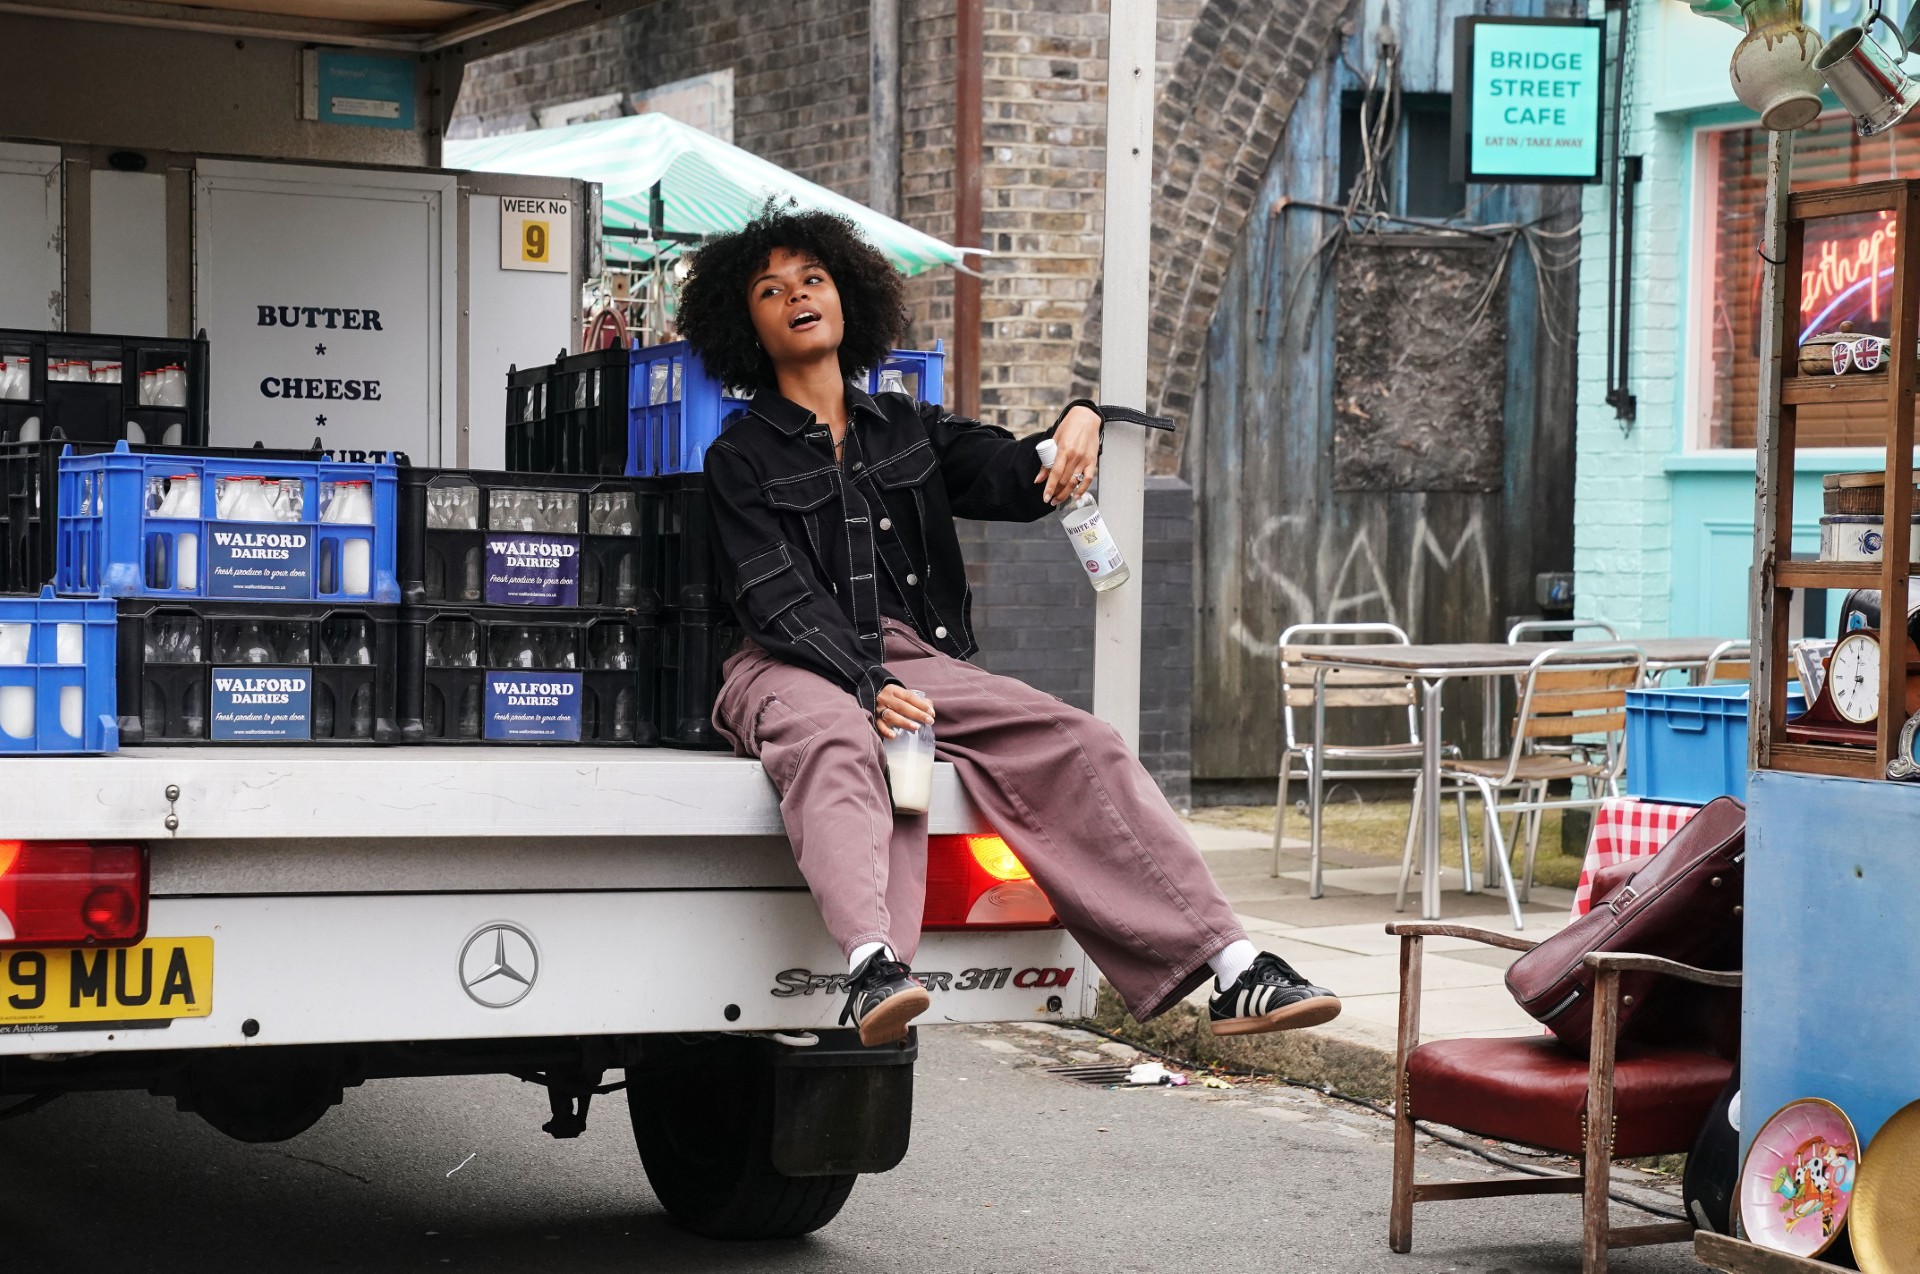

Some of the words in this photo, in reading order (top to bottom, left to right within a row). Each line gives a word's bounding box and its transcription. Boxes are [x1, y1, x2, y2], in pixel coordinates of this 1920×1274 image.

[1490, 51, 1582, 70] BRIDGE
[1489, 78, 1581, 98] STREET
[1504, 107, 1566, 125] CAFE
[1484, 136, 1504, 147] EAT
[1506, 137, 1518, 147] IN
[1526, 137, 1553, 148] TAKE
[1555, 137, 1583, 148] AWAY
[503, 199, 545, 214] WEEK
[549, 201, 567, 214] No
[526, 224, 545, 259] 9
[257, 305, 383, 331] BUTTER
[260, 376, 381, 401] CHEESE
[1066, 523, 1089, 536] WHITE
[214, 532, 306, 548] WALFORD
[231, 548, 289, 559] DAIRIES
[490, 542, 574, 557] WALFORD
[506, 557, 560, 568] DAIRIES
[214, 566, 233, 575] Fresh
[233, 567, 262, 577] produce
[263, 568, 270, 576] to
[270, 569, 288, 580] your
[490, 574, 508, 583] Fresh
[508, 575, 535, 584] produce
[536, 576, 542, 584] to
[542, 578, 559, 588] your
[1229, 510, 1492, 656] SAM
[215, 678, 306, 692] WALFORD
[493, 682, 574, 695] WALFORD
[231, 693, 289, 704] DAIRIES
[508, 696, 559, 706] DAIRIES
[215, 711, 234, 721] Fresh
[234, 712, 262, 722] produce
[263, 713, 270, 721] to
[270, 713, 288, 725] your
[493, 712, 510, 721] Fresh
[510, 712, 535, 722] produce
[535, 713, 542, 721] to
[541, 714, 556, 724] your
[0, 951, 46, 1009] 9
[70, 947, 196, 1008] MUA
[955, 966, 1012, 990] 311
[1013, 966, 1075, 989] CDI
[12, 1023, 58, 1034] Autolease
